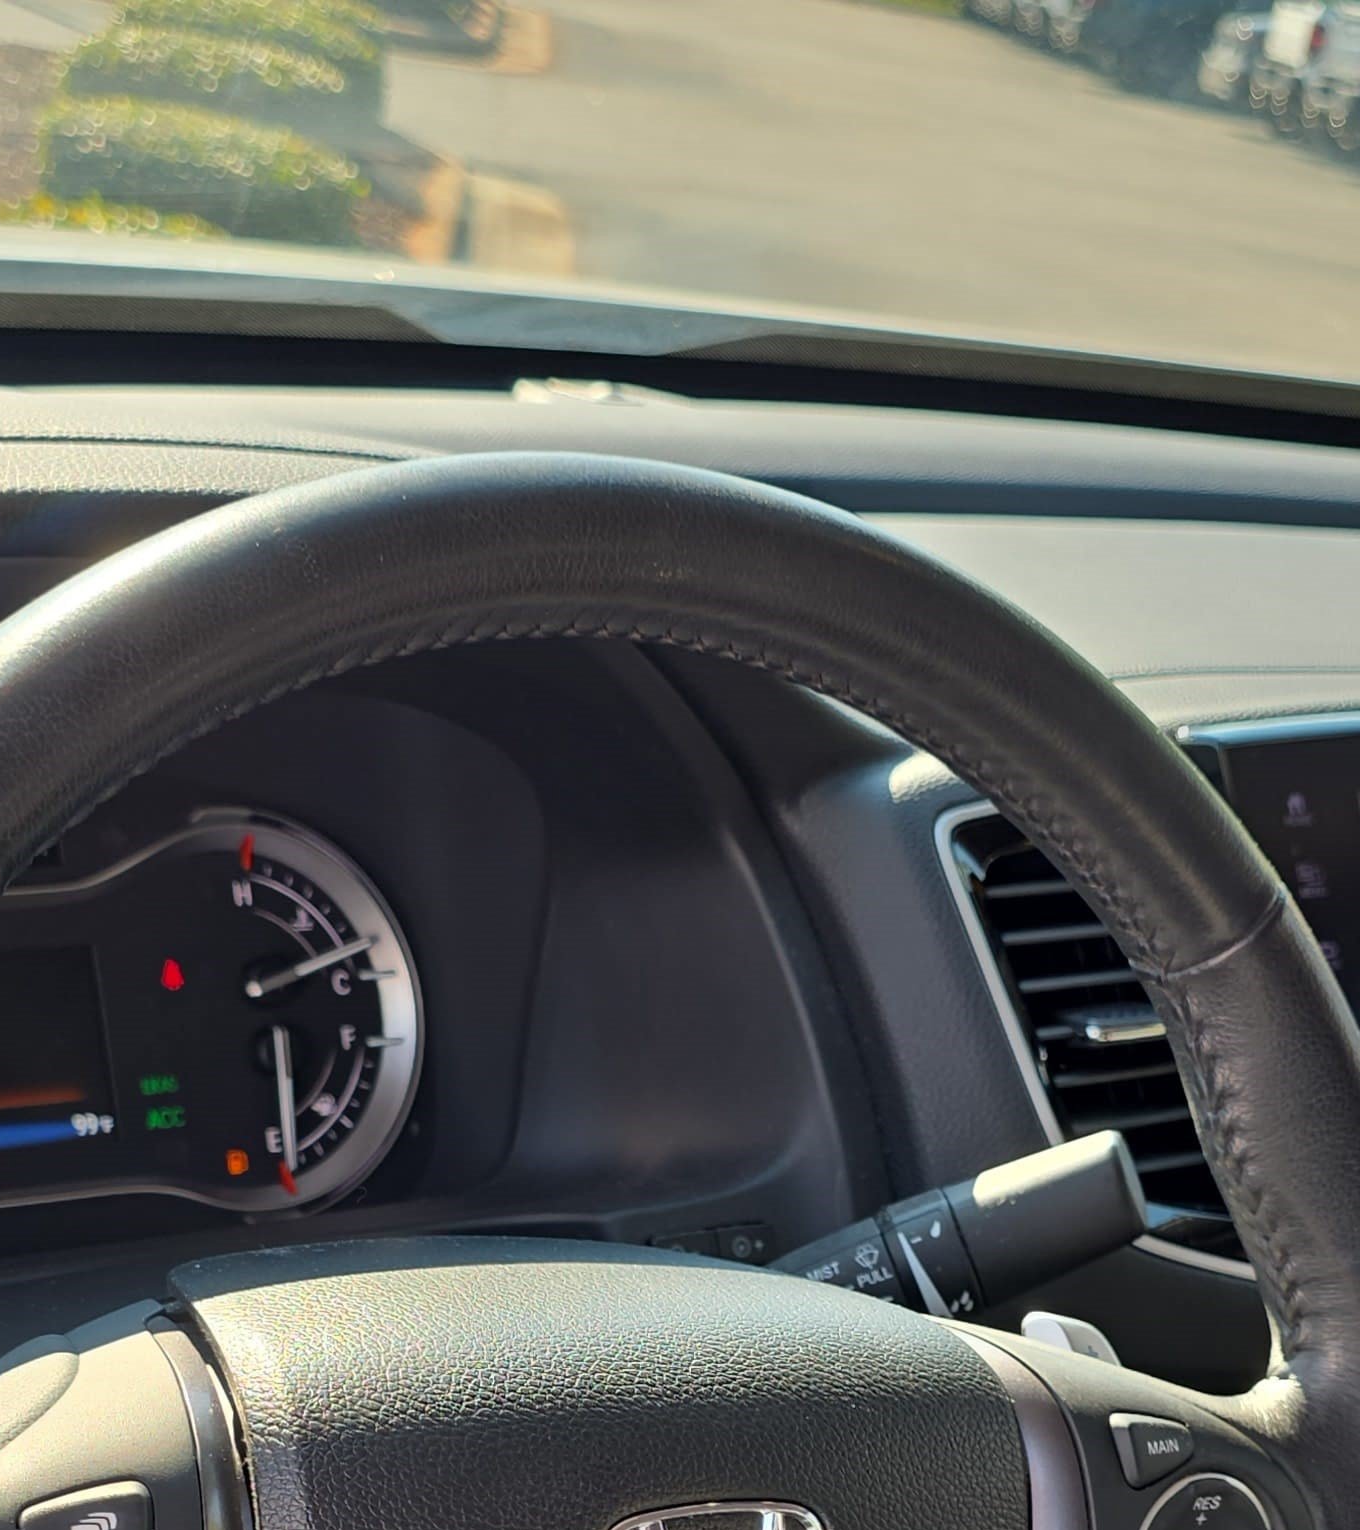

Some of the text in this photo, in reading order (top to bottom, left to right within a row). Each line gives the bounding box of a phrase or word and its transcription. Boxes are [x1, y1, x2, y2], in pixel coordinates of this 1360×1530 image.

[265, 1126, 283, 1153] E
[856, 1267, 894, 1289] PULL
[1146, 1439, 1180, 1455] MAIN
[1192, 1495, 1223, 1511] RES
